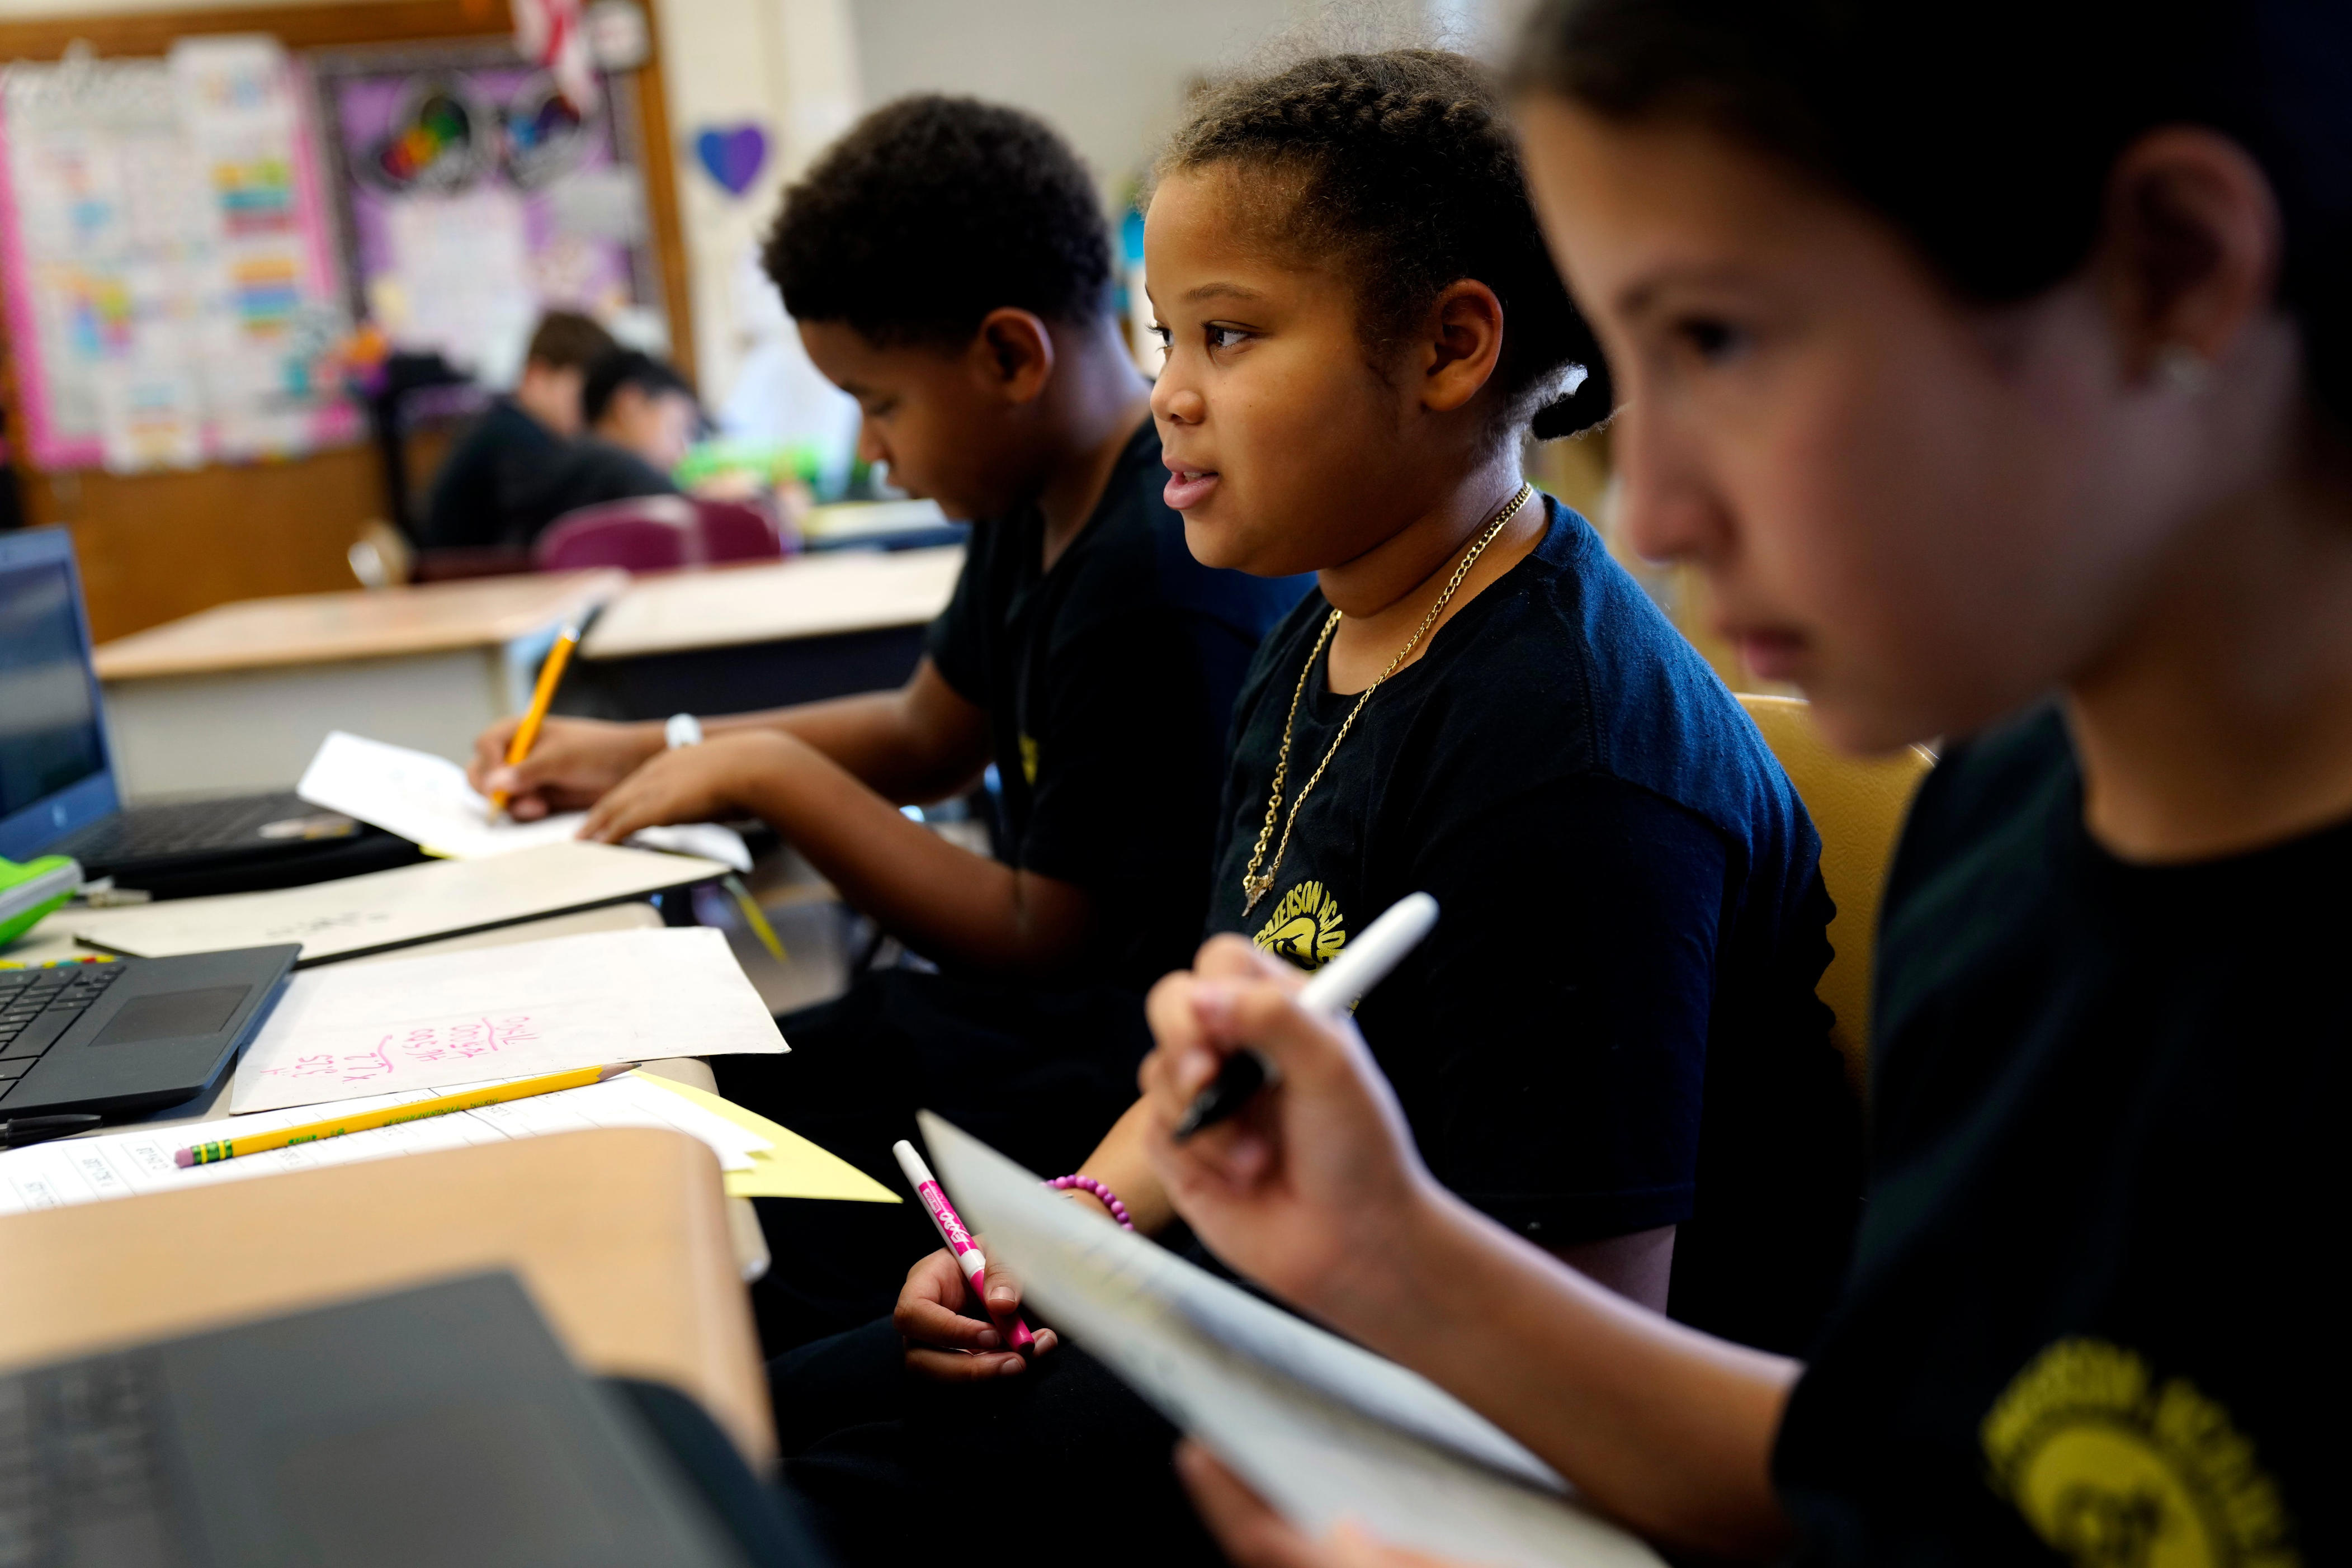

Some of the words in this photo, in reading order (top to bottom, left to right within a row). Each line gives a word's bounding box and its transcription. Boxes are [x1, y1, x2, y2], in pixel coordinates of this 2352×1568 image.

[1253, 880, 1323, 947] PATERSON
[470, 1098, 499, 1108] DIXON
[939, 1211, 970, 1244] EXPO
